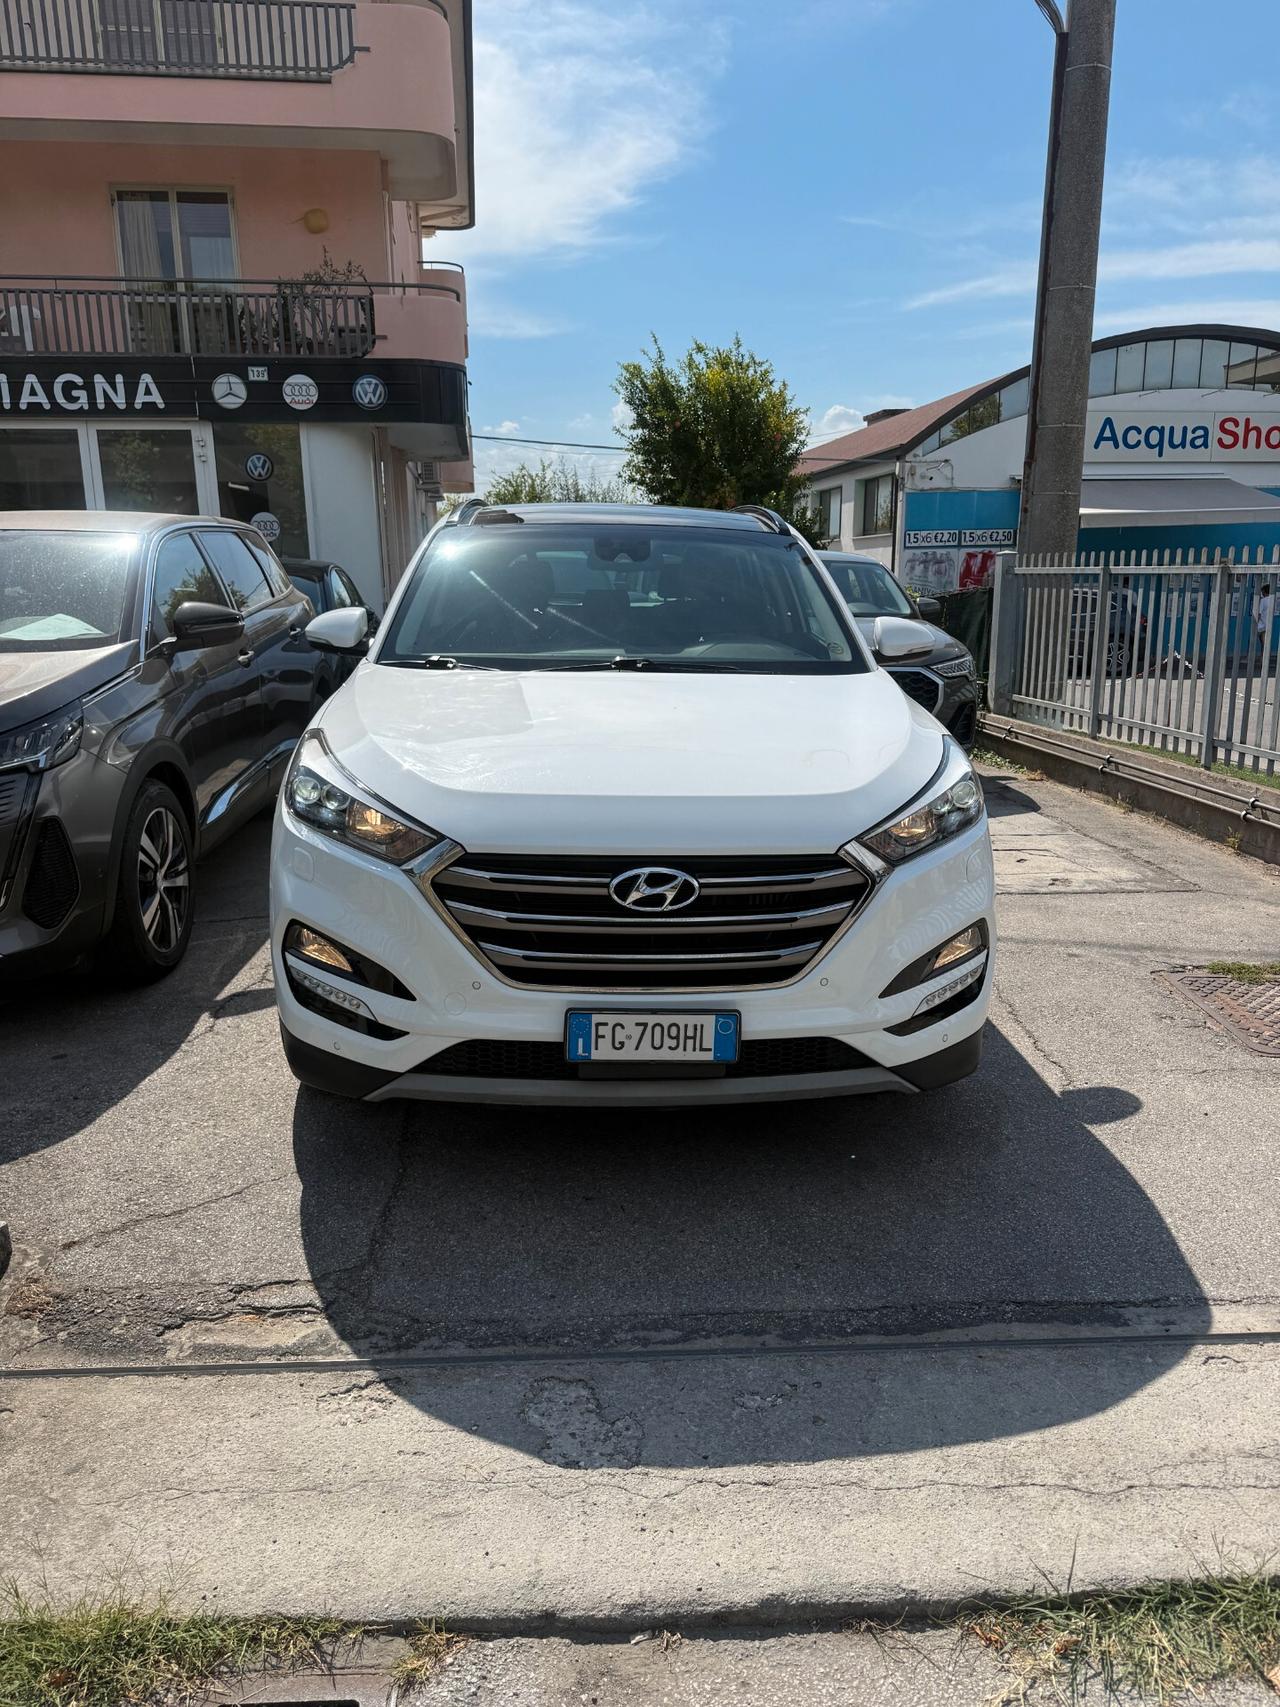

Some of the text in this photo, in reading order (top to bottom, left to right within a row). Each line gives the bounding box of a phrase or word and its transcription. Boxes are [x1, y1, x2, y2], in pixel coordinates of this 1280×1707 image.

[0, 373, 165, 410] AGNA
[1093, 416, 1280, 458] Acqua Sho
[906, 531, 957, 545] 1,5 x6 €2,20
